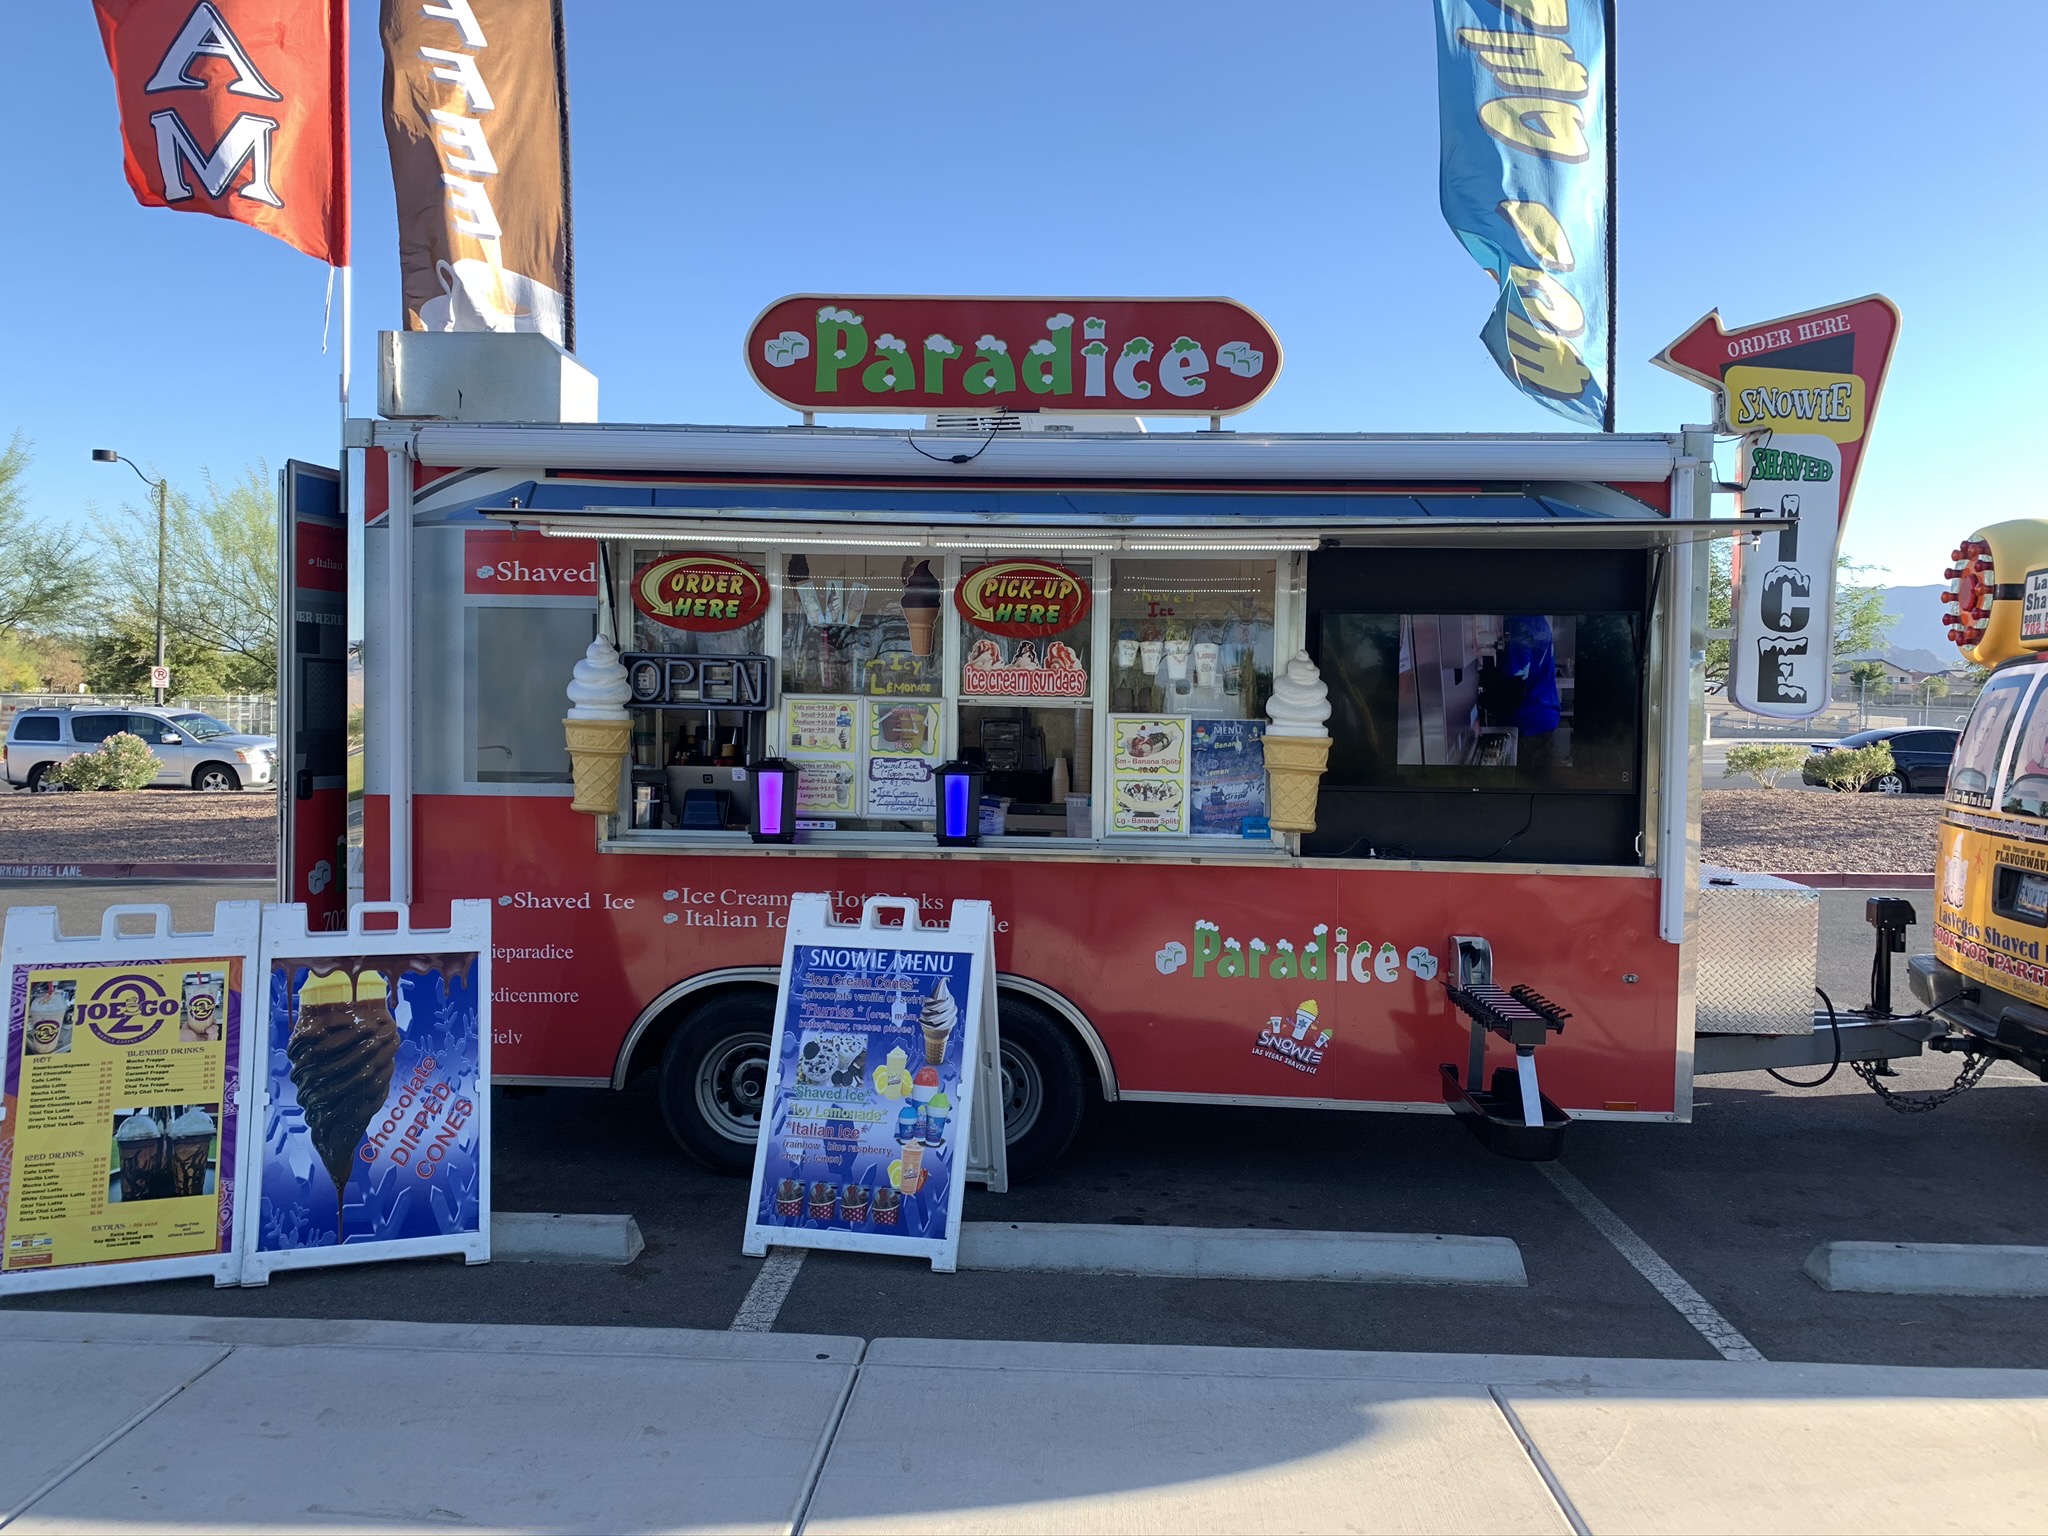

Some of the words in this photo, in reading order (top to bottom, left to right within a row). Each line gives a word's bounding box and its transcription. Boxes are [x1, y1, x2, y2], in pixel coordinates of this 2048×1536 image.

[1727, 328, 1792, 359] ORDER
[1798, 313, 1851, 342] HERE
[815, 306, 1209, 399] Paradice
[1738, 382, 1851, 424] SNOWIE
[1752, 447, 1834, 482] SHAVED
[316, 557, 343, 571] Italian
[496, 561, 597, 583] Shaved
[671, 574, 744, 595] ORDER
[984, 579, 1073, 600] PICK-UP
[674, 598, 740, 618] HERE
[1757, 494, 1811, 704] ICE
[2026, 592, 2047, 611] Sha
[315, 612, 344, 626] HERE
[995, 603, 1061, 625] HERE
[2024, 613, 2041, 624] BOOK
[630, 660, 762, 704] OPEN
[967, 666, 986, 691] ice
[989, 671, 1029, 691] cream
[1033, 668, 1083, 692] sundaes
[1213, 726, 1242, 735] MENU
[874, 761, 902, 770] Shaved
[903, 761, 919, 770] Ice
[1161, 758, 1182, 766] Splits
[877, 786, 891, 796] Ice
[31, 865, 54, 876] FIRE
[56, 865, 82, 876] LANE
[513, 892, 591, 910] Shaved
[603, 892, 635, 910] Ice
[681, 887, 715, 905] Ice
[720, 888, 789, 907] Cream
[685, 909, 758, 928] Italian
[766, 912, 787, 929] Ic
[1192, 919, 1400, 983] Paradice
[1960, 938, 1989, 966] FOR
[1984, 926, 2039, 960] Shaved
[809, 949, 888, 970] SNOWIE
[893, 953, 953, 973] MENU
[832, 974, 872, 987] Cream
[854, 991, 885, 1003] vanilla
[75, 1002, 122, 1025] JOE
[106, 983, 146, 1034] 2
[139, 999, 179, 1017] GO
[490, 1028, 523, 1045] ielv
[127, 1048, 169, 1057] BLENDED
[170, 1046, 205, 1054] DRINKS
[1256, 1029, 1324, 1065] SNOWIE
[32, 1056, 53, 1064] HOT
[1251, 1047, 1264, 1057] LAS
[1264, 1050, 1284, 1062] VEGAS
[1284, 1057, 1306, 1072] SHAVED
[1306, 1066, 1317, 1075] ICE
[359, 1056, 436, 1164] Chocolate
[390, 1081, 451, 1168] DIPPED
[416, 1100, 473, 1180] CONES
[827, 1141, 846, 1152] blue
[24, 1153, 46, 1162] ICED
[48, 1150, 85, 1160] DRINKS
[91, 1222, 126, 1232] EXTRAS
